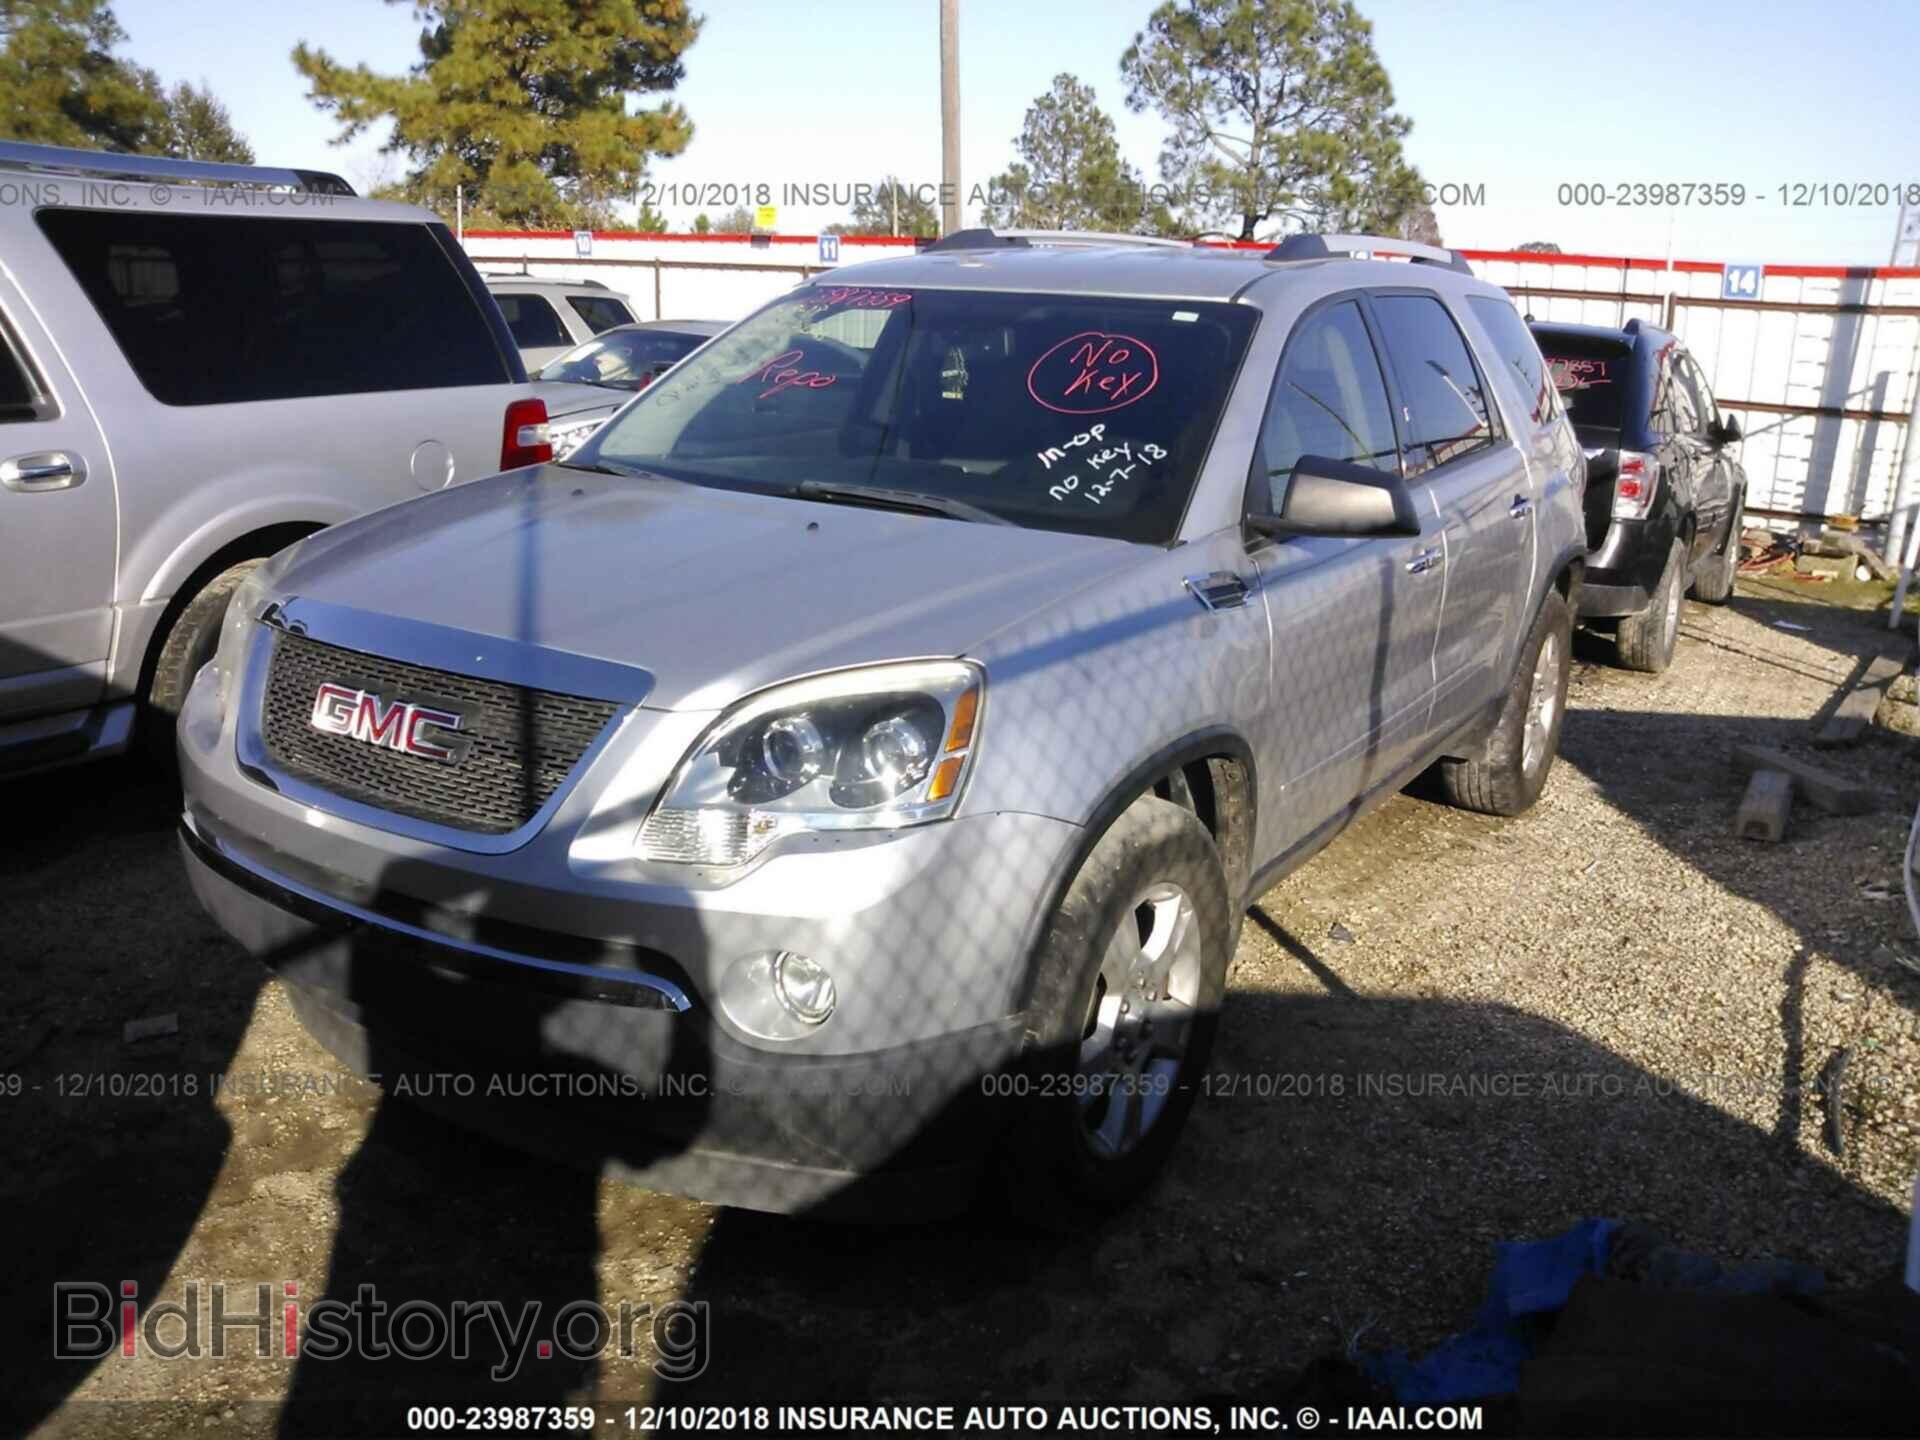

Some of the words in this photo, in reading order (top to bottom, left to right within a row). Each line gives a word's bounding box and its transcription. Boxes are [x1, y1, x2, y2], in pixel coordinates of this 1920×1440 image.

[823, 240, 836, 258] 11
[1728, 269, 1757, 294] 14
[1084, 443, 1168, 504] 12-7-18
[311, 682, 465, 764] GMC
